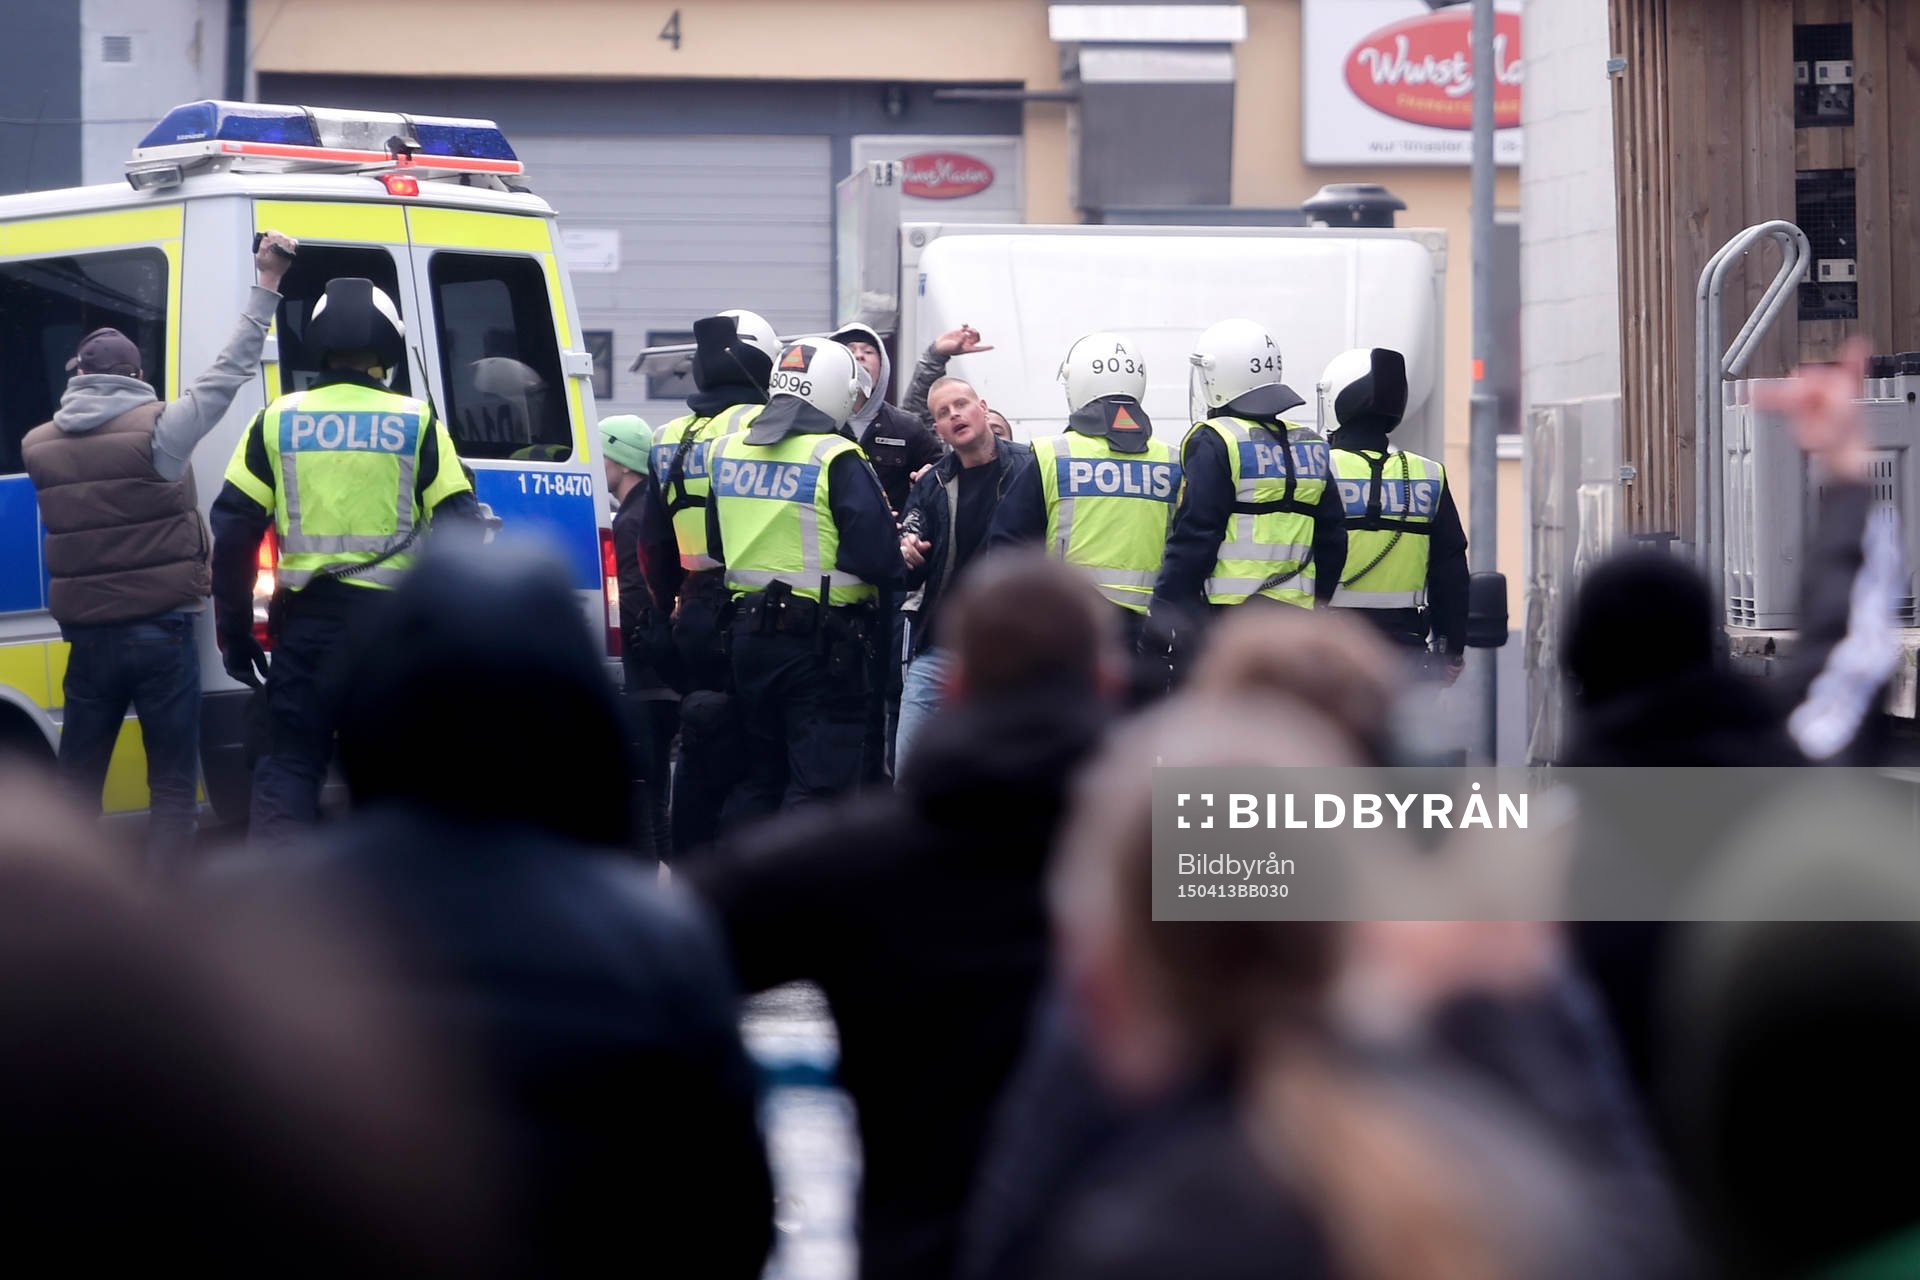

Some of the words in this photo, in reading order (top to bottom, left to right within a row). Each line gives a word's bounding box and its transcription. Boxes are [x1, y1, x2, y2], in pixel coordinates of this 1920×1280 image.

[657, 9, 681, 50] 4
[1115, 343, 1127, 354] A
[1265, 334, 1275, 348] A
[1092, 358, 1144, 377] 9034
[291, 414, 405, 451] POLIS
[518, 473, 527, 494] 1
[531, 473, 592, 497] 71-8470
[719, 461, 802, 498] POLIS
[1069, 461, 1172, 498] POLIS
